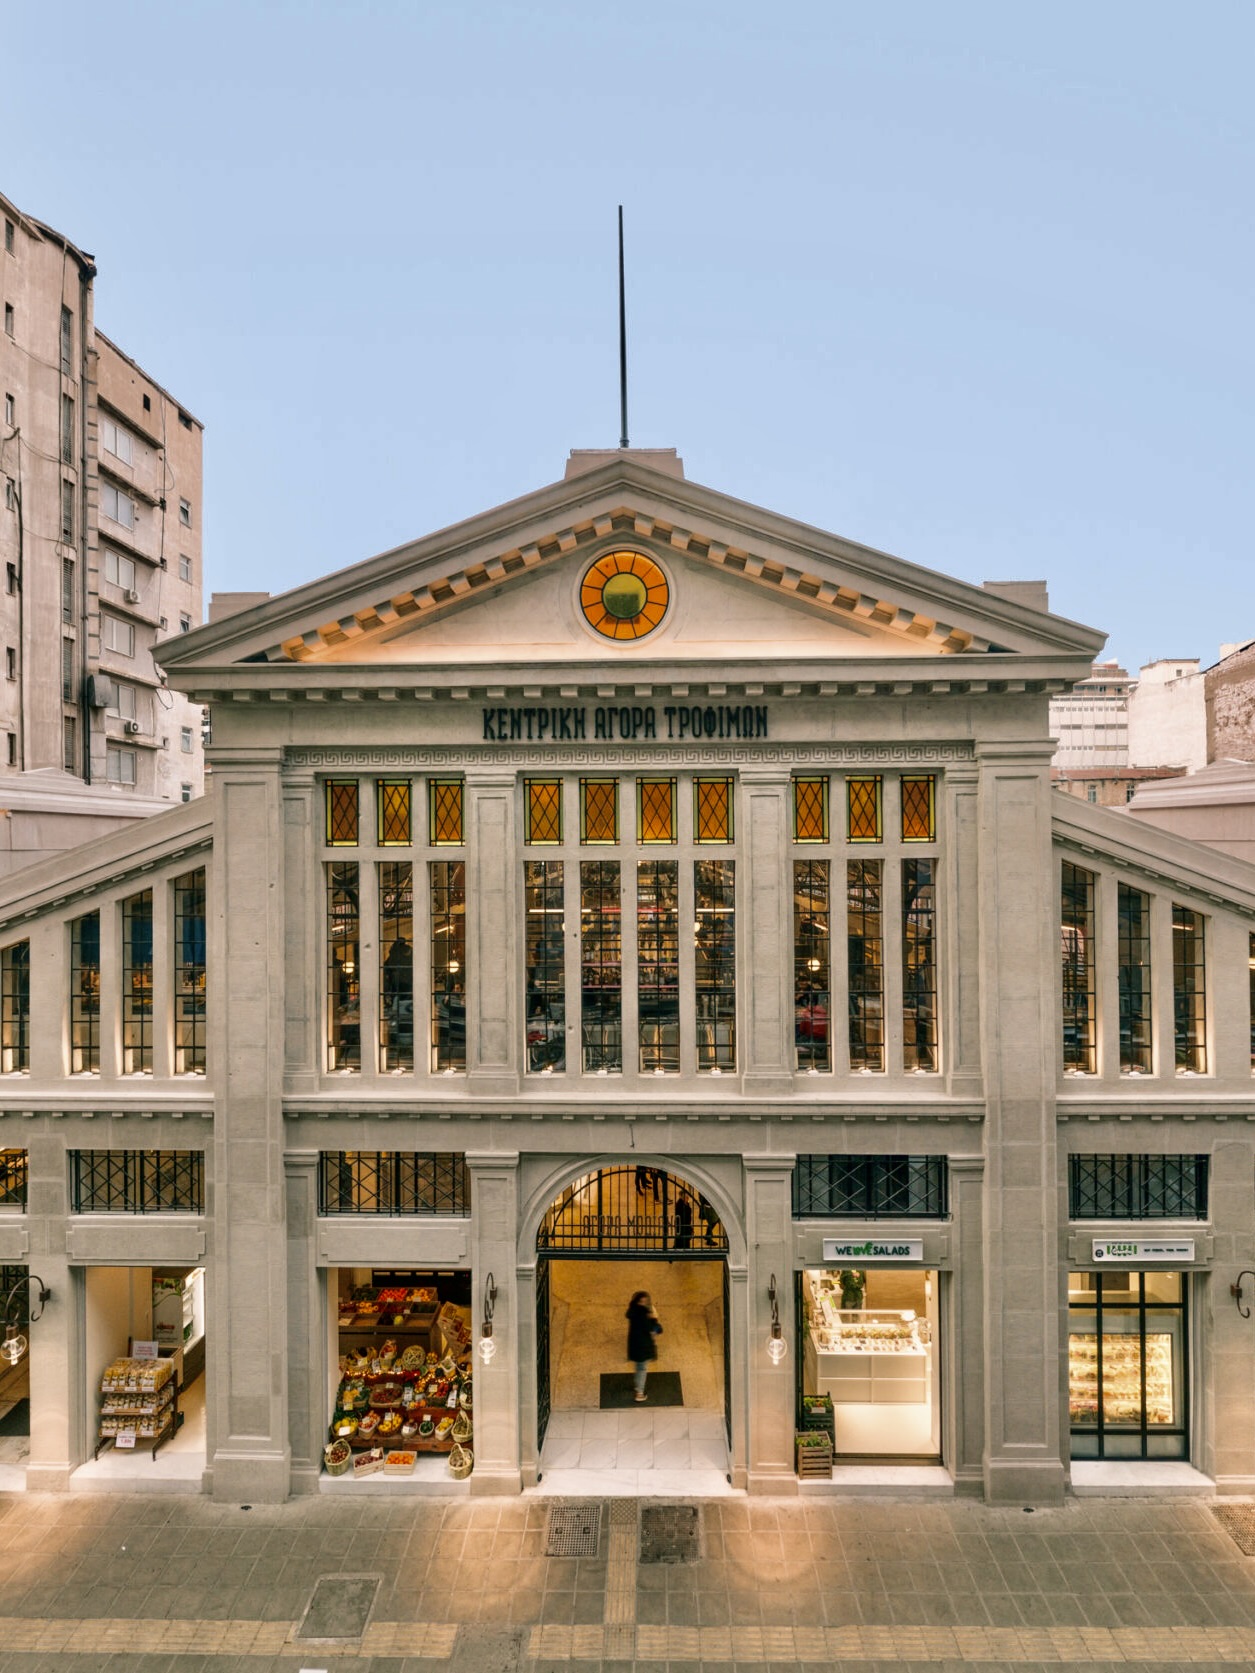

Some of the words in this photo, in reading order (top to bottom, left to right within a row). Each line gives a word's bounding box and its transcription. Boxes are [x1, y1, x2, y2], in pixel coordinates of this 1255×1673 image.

[482, 708, 586, 740] ΚΕΝΤΡΙΚΗ
[594, 707, 657, 739] ΑΓΟΡΑ
[664, 705, 768, 738] ΤΡΟΦΙΜΩΝ
[835, 1246, 852, 1255] WE
[873, 1246, 910, 1255] SALADS
